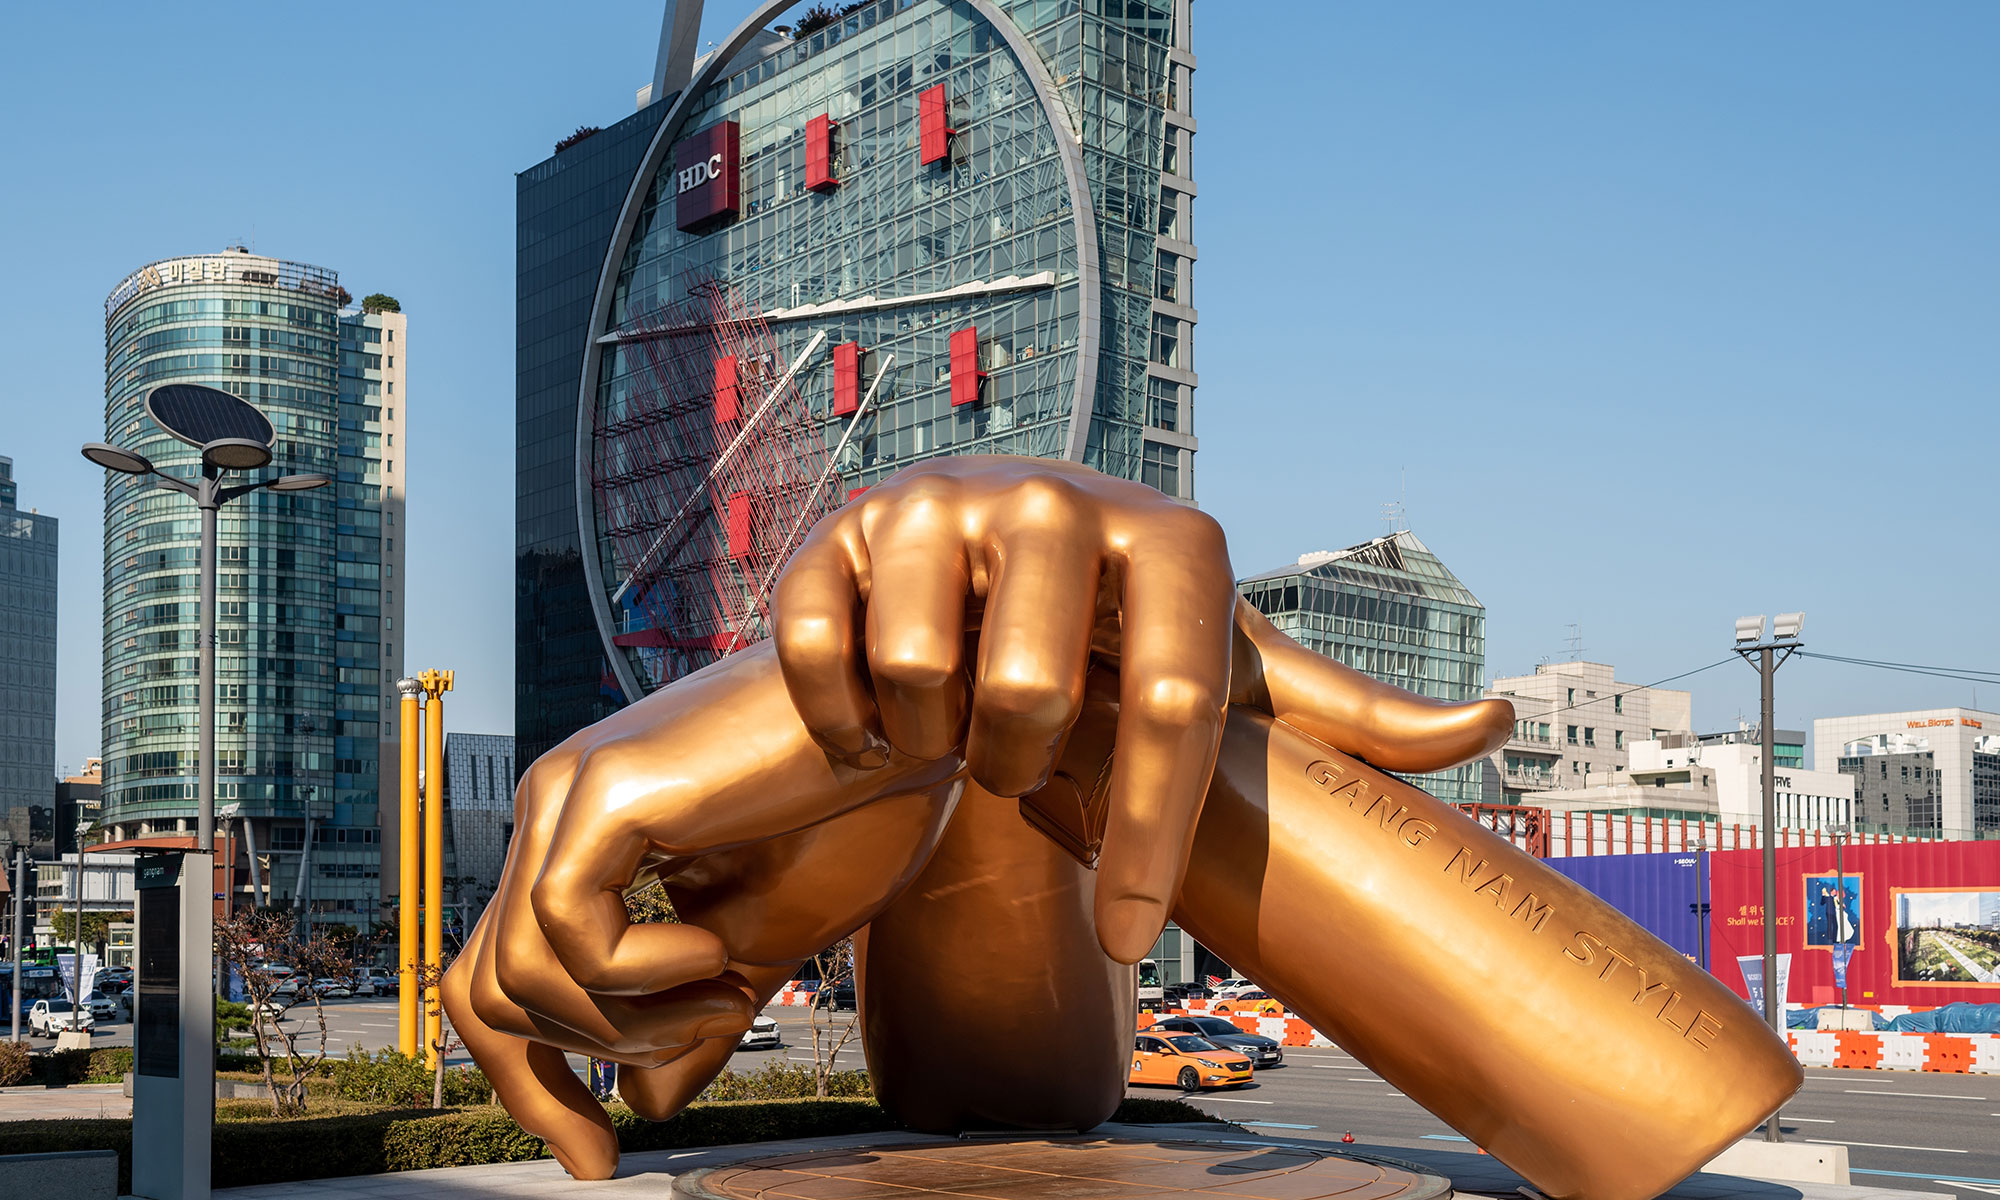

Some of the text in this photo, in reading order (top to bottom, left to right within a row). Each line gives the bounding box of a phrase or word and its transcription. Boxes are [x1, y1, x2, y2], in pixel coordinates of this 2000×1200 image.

[678, 153, 722, 194] HDC
[168, 259, 227, 282] 미켈란
[143, 866, 164, 879] gangnam
[1305, 759, 1724, 1052] GANG NAM STYLE
[1727, 916, 1746, 926] Shall
[1760, 916, 1788, 926] DCE
